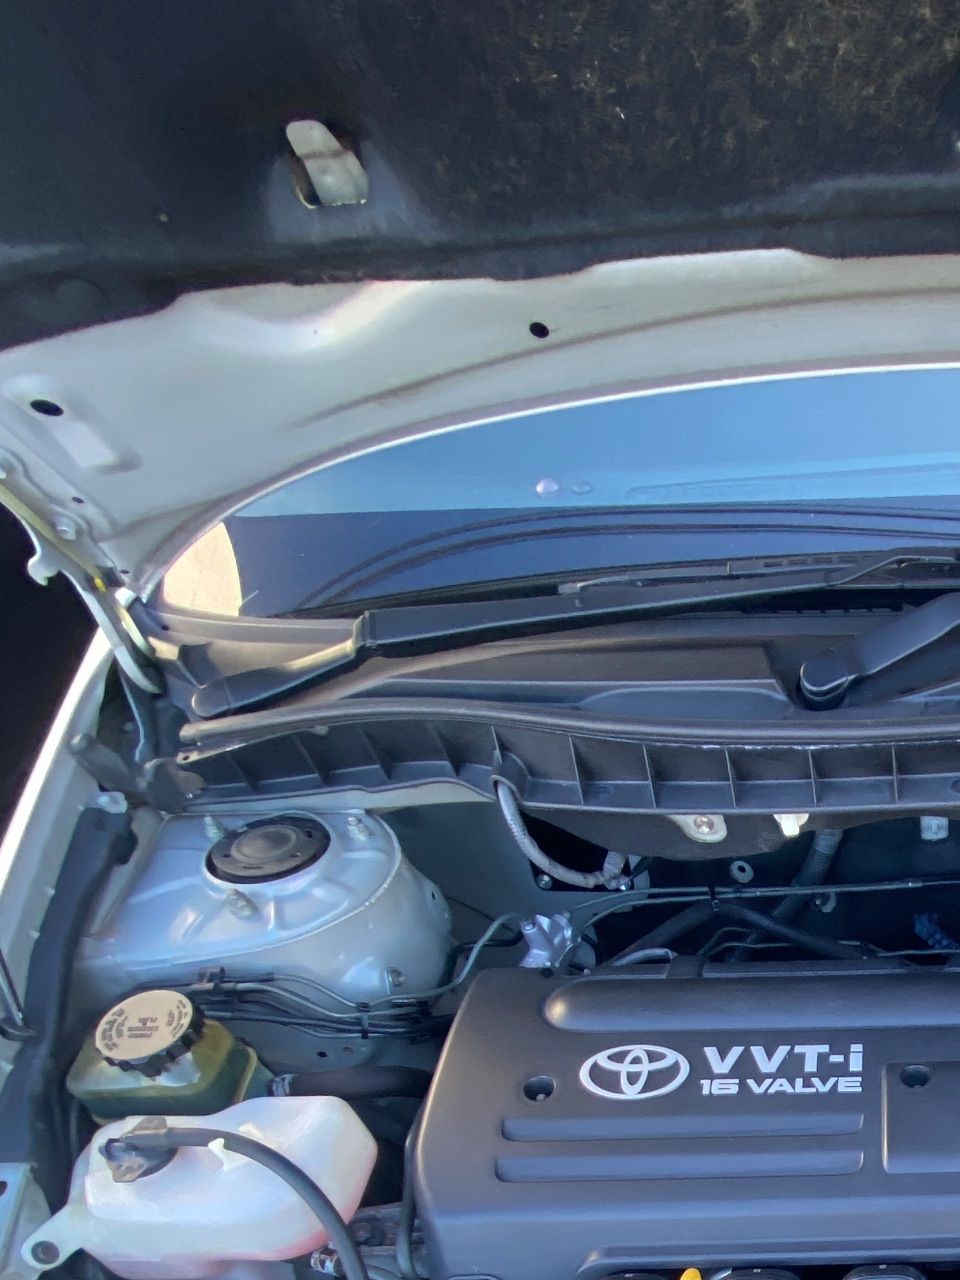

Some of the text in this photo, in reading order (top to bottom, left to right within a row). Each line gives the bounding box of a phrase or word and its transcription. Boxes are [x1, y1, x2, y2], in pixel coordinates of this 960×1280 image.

[703, 1043, 865, 1074] VVT-i
[700, 1076, 863, 1095] 16 VALVE
